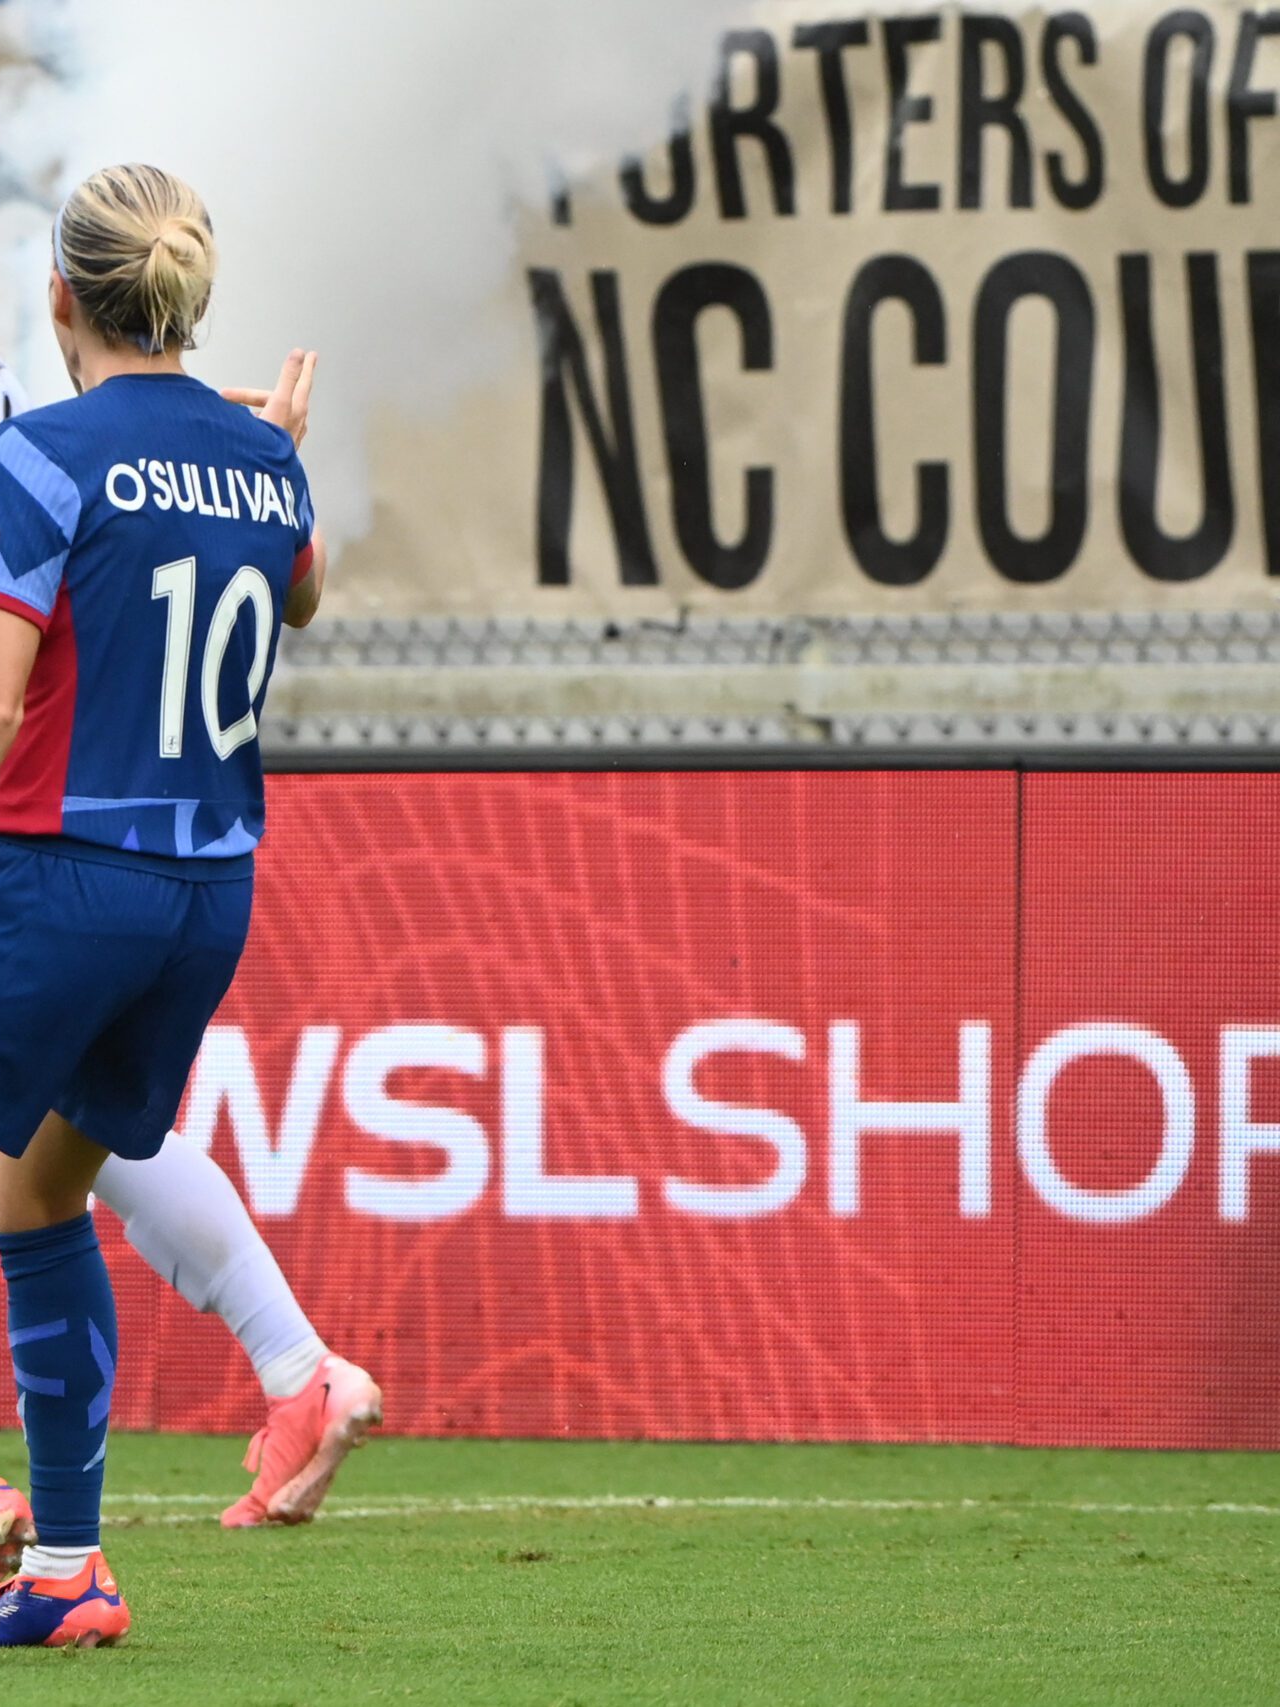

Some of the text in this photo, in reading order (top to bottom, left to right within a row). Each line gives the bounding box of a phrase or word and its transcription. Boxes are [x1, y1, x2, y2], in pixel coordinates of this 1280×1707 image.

[1141, 9, 1280, 210] OF
[526, 260, 774, 591] NC
[150, 555, 274, 762] 10
